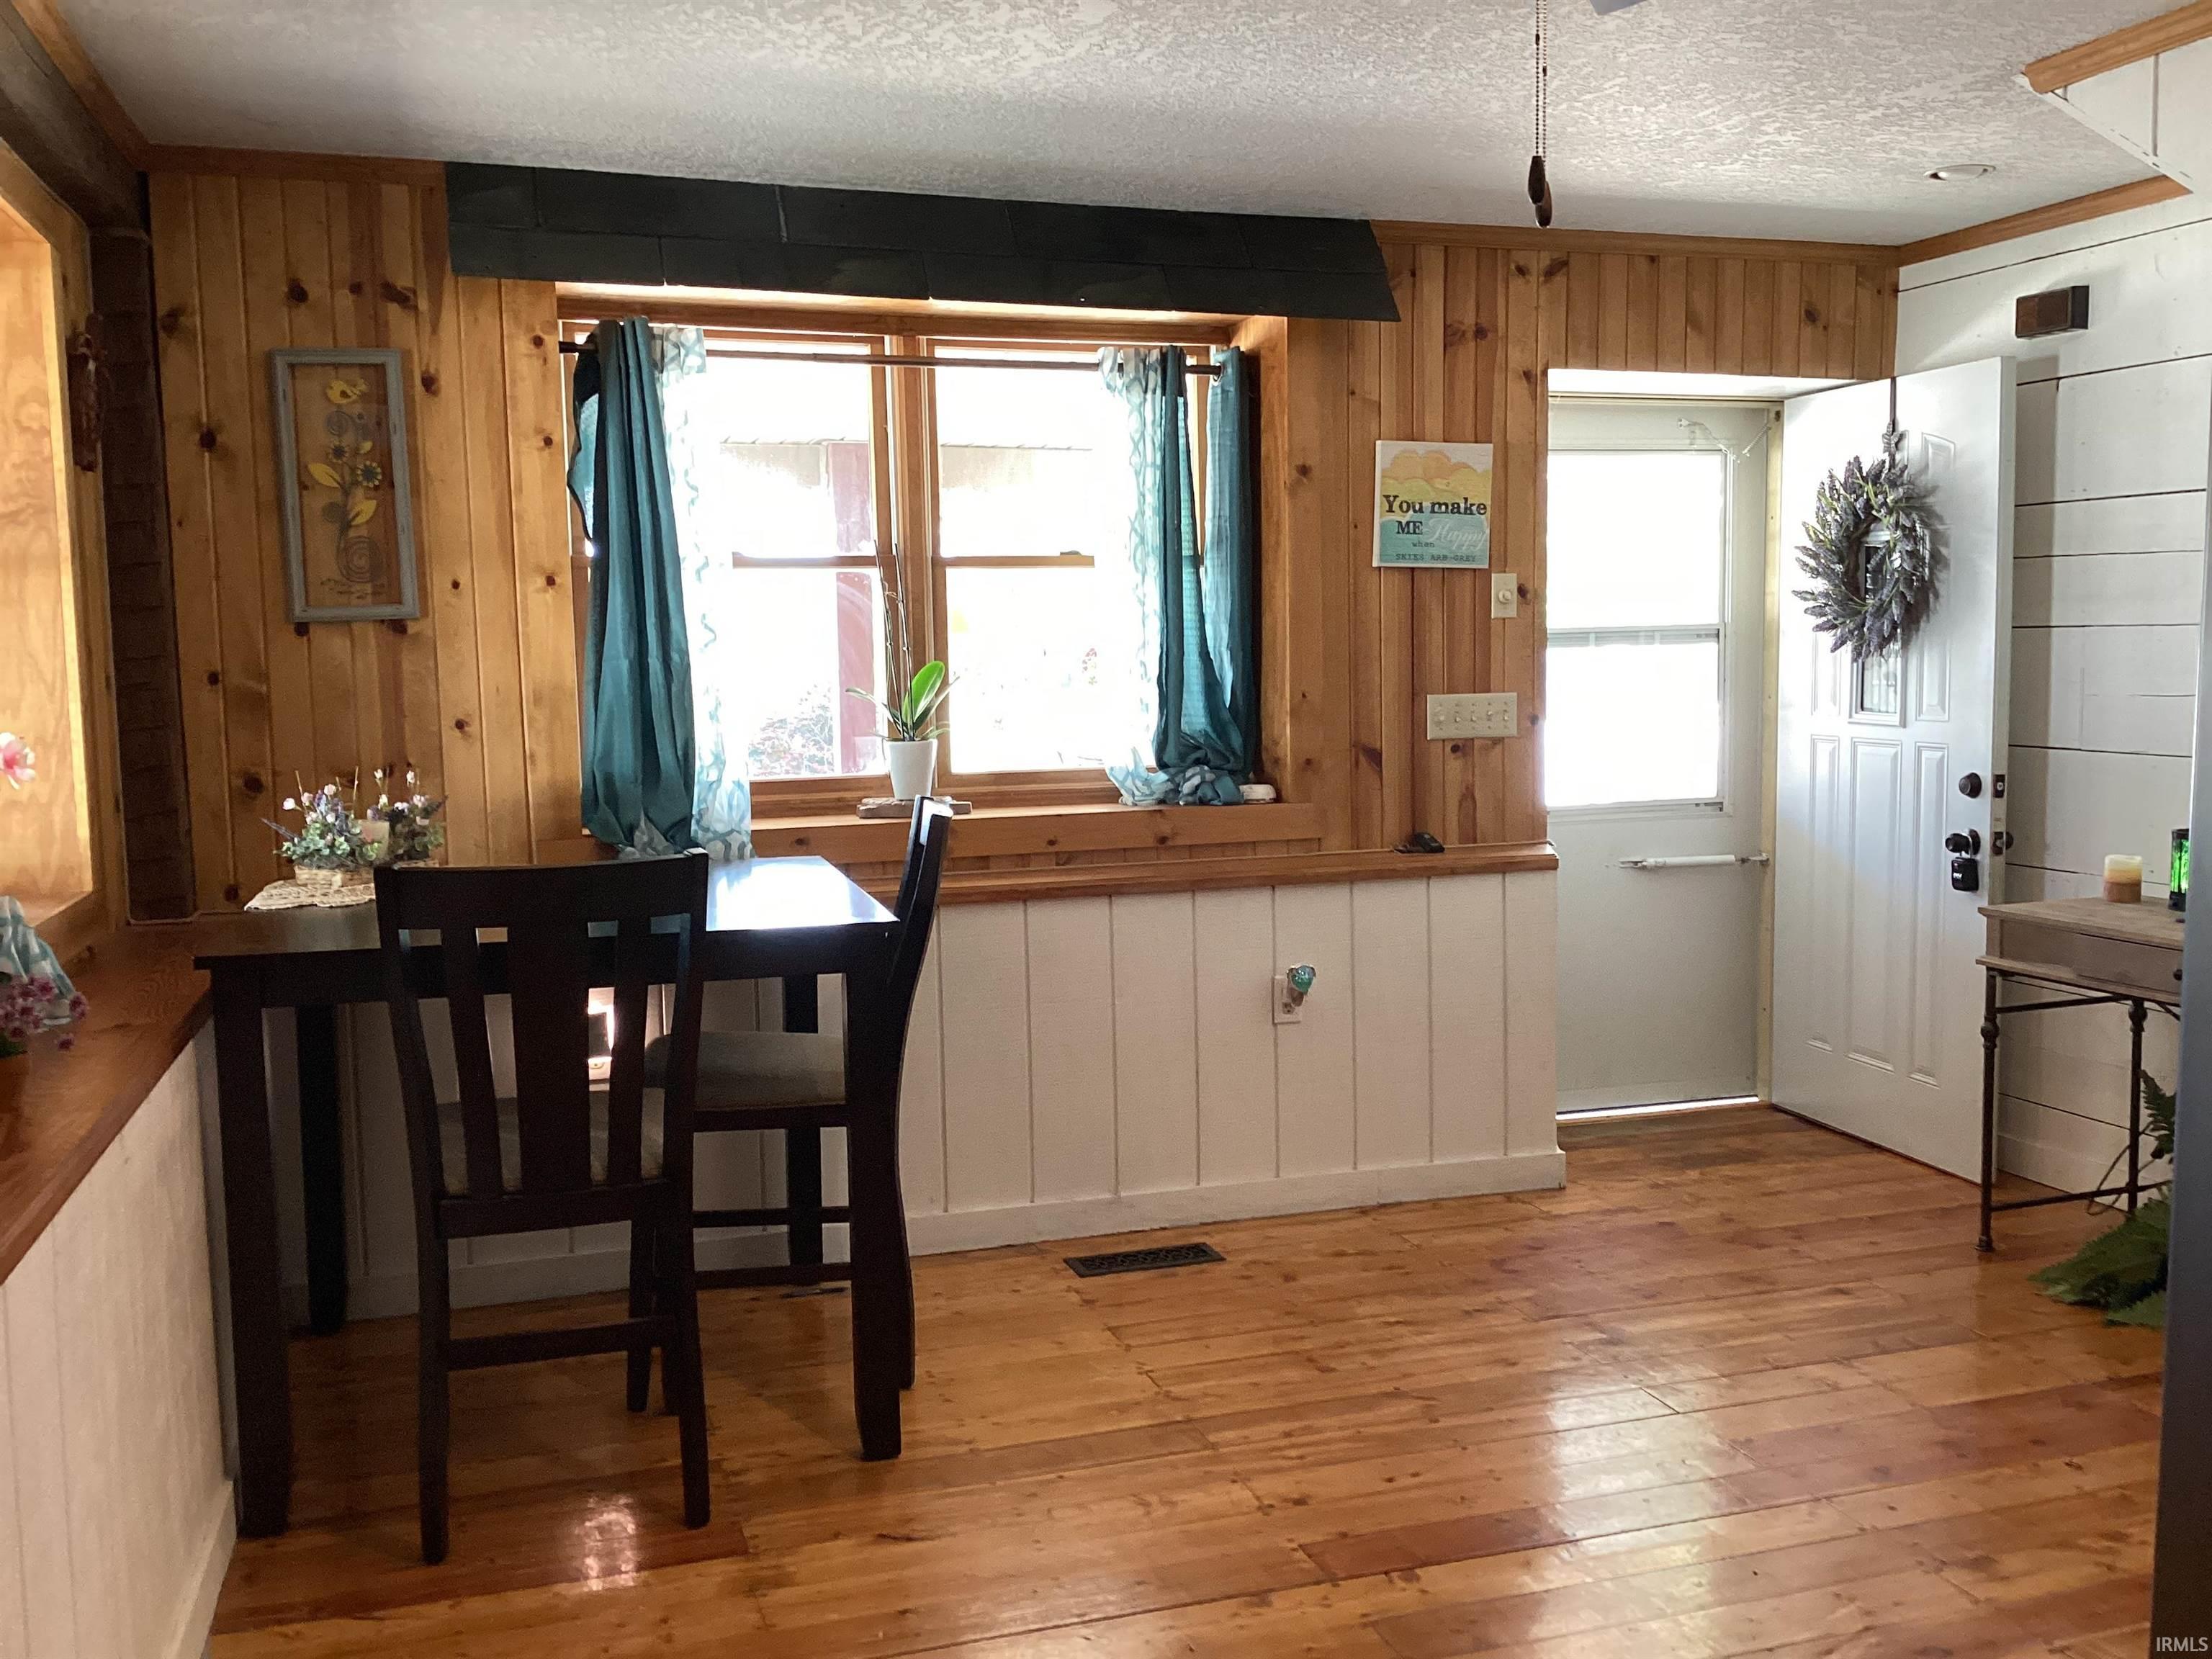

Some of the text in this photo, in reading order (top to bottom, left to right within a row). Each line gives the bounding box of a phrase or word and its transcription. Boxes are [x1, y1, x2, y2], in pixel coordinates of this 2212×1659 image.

[1382, 495, 1487, 515] You make
[1396, 521, 1423, 535] ME
[1395, 553, 1424, 562] SKIES
